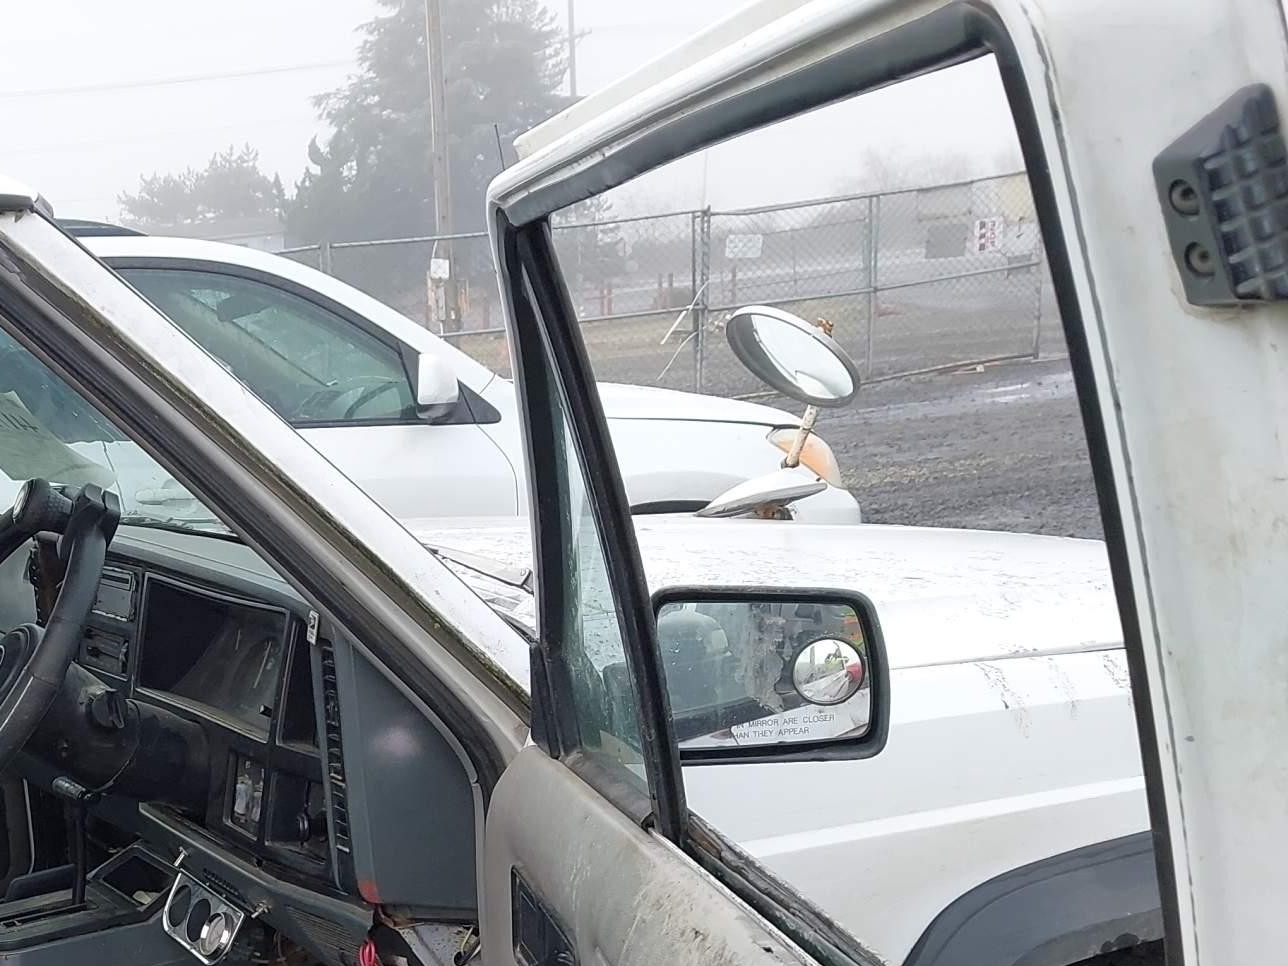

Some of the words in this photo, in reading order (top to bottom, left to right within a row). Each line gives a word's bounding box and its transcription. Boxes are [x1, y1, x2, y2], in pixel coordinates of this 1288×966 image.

[748, 718, 779, 728] MIRROR
[783, 717, 799, 725] ARE
[802, 713, 835, 724] CLOSER
[752, 729, 774, 738] THEY
[777, 726, 810, 737] APPEAR
